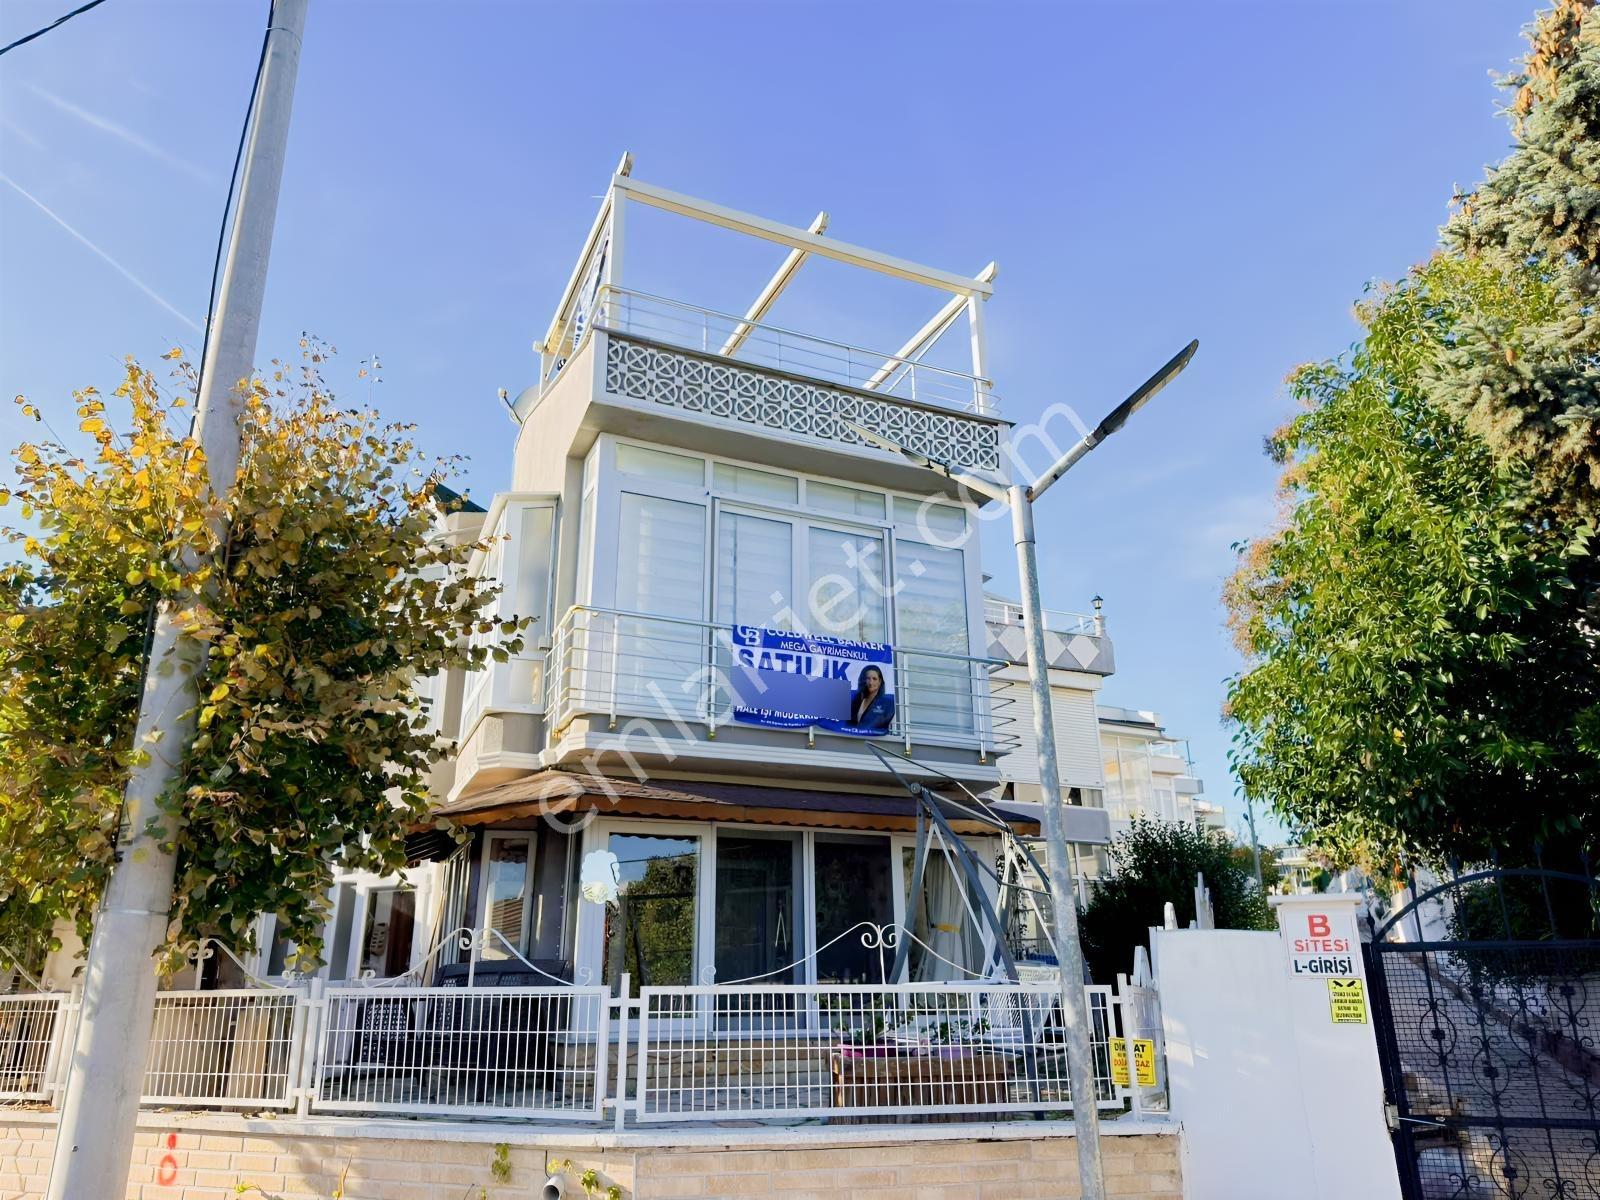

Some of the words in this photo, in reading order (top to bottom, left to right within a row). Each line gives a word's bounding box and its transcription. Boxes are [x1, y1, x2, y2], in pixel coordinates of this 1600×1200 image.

[780, 641, 807, 653] MEGA
[1307, 914, 1331, 938] B
[1294, 956, 1353, 975] L-GİRİŞİ
